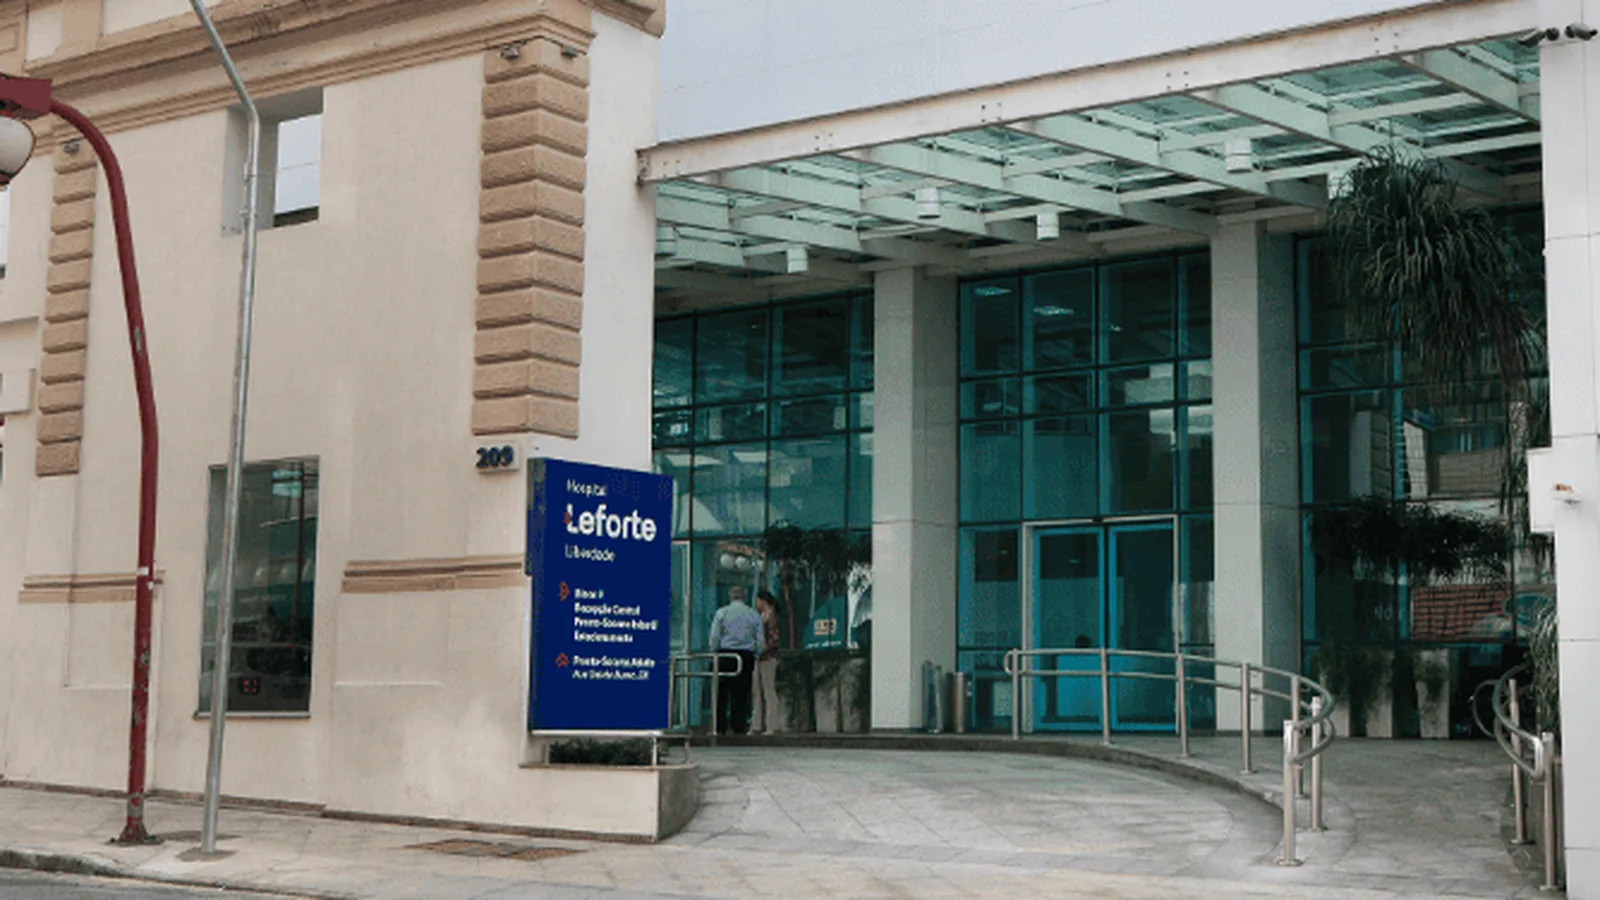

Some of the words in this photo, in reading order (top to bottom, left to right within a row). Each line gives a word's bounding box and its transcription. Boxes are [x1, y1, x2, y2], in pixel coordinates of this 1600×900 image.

[476, 446, 514, 468] 209
[566, 479, 607, 498] Hospital
[566, 502, 657, 542] Leforte
